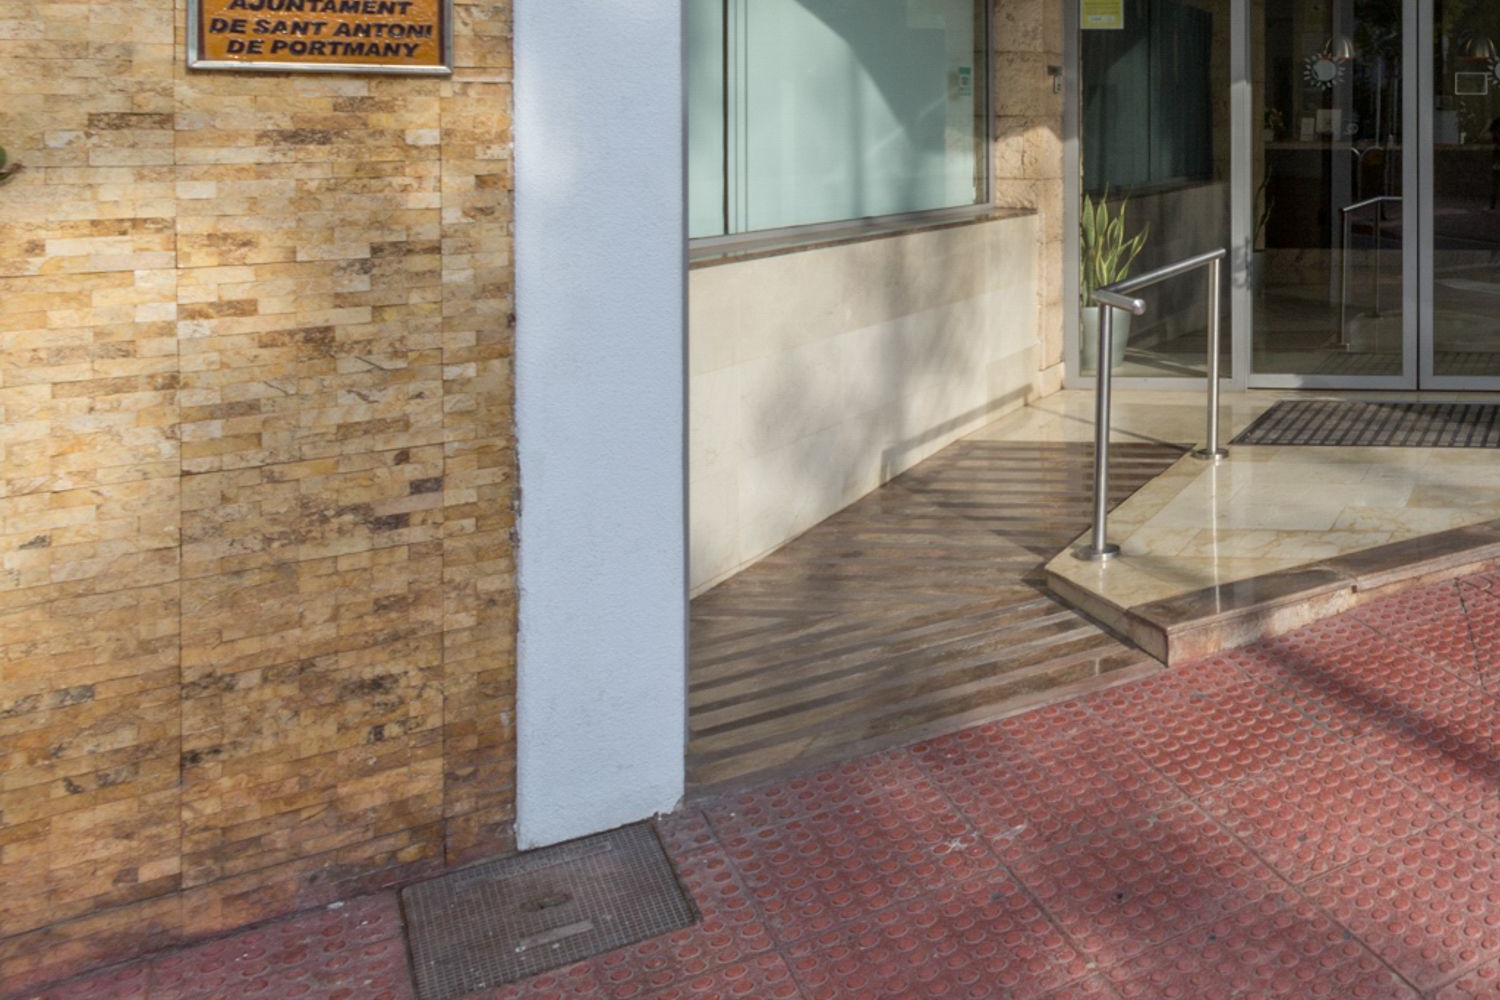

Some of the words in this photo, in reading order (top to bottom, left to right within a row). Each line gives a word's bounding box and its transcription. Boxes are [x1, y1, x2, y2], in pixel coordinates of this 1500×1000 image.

[209, 17, 248, 34] DE
[252, 19, 328, 37] SANT
[333, 22, 434, 39] ANTONI
[226, 38, 265, 56] DE
[270, 39, 421, 58] PORTMANY
